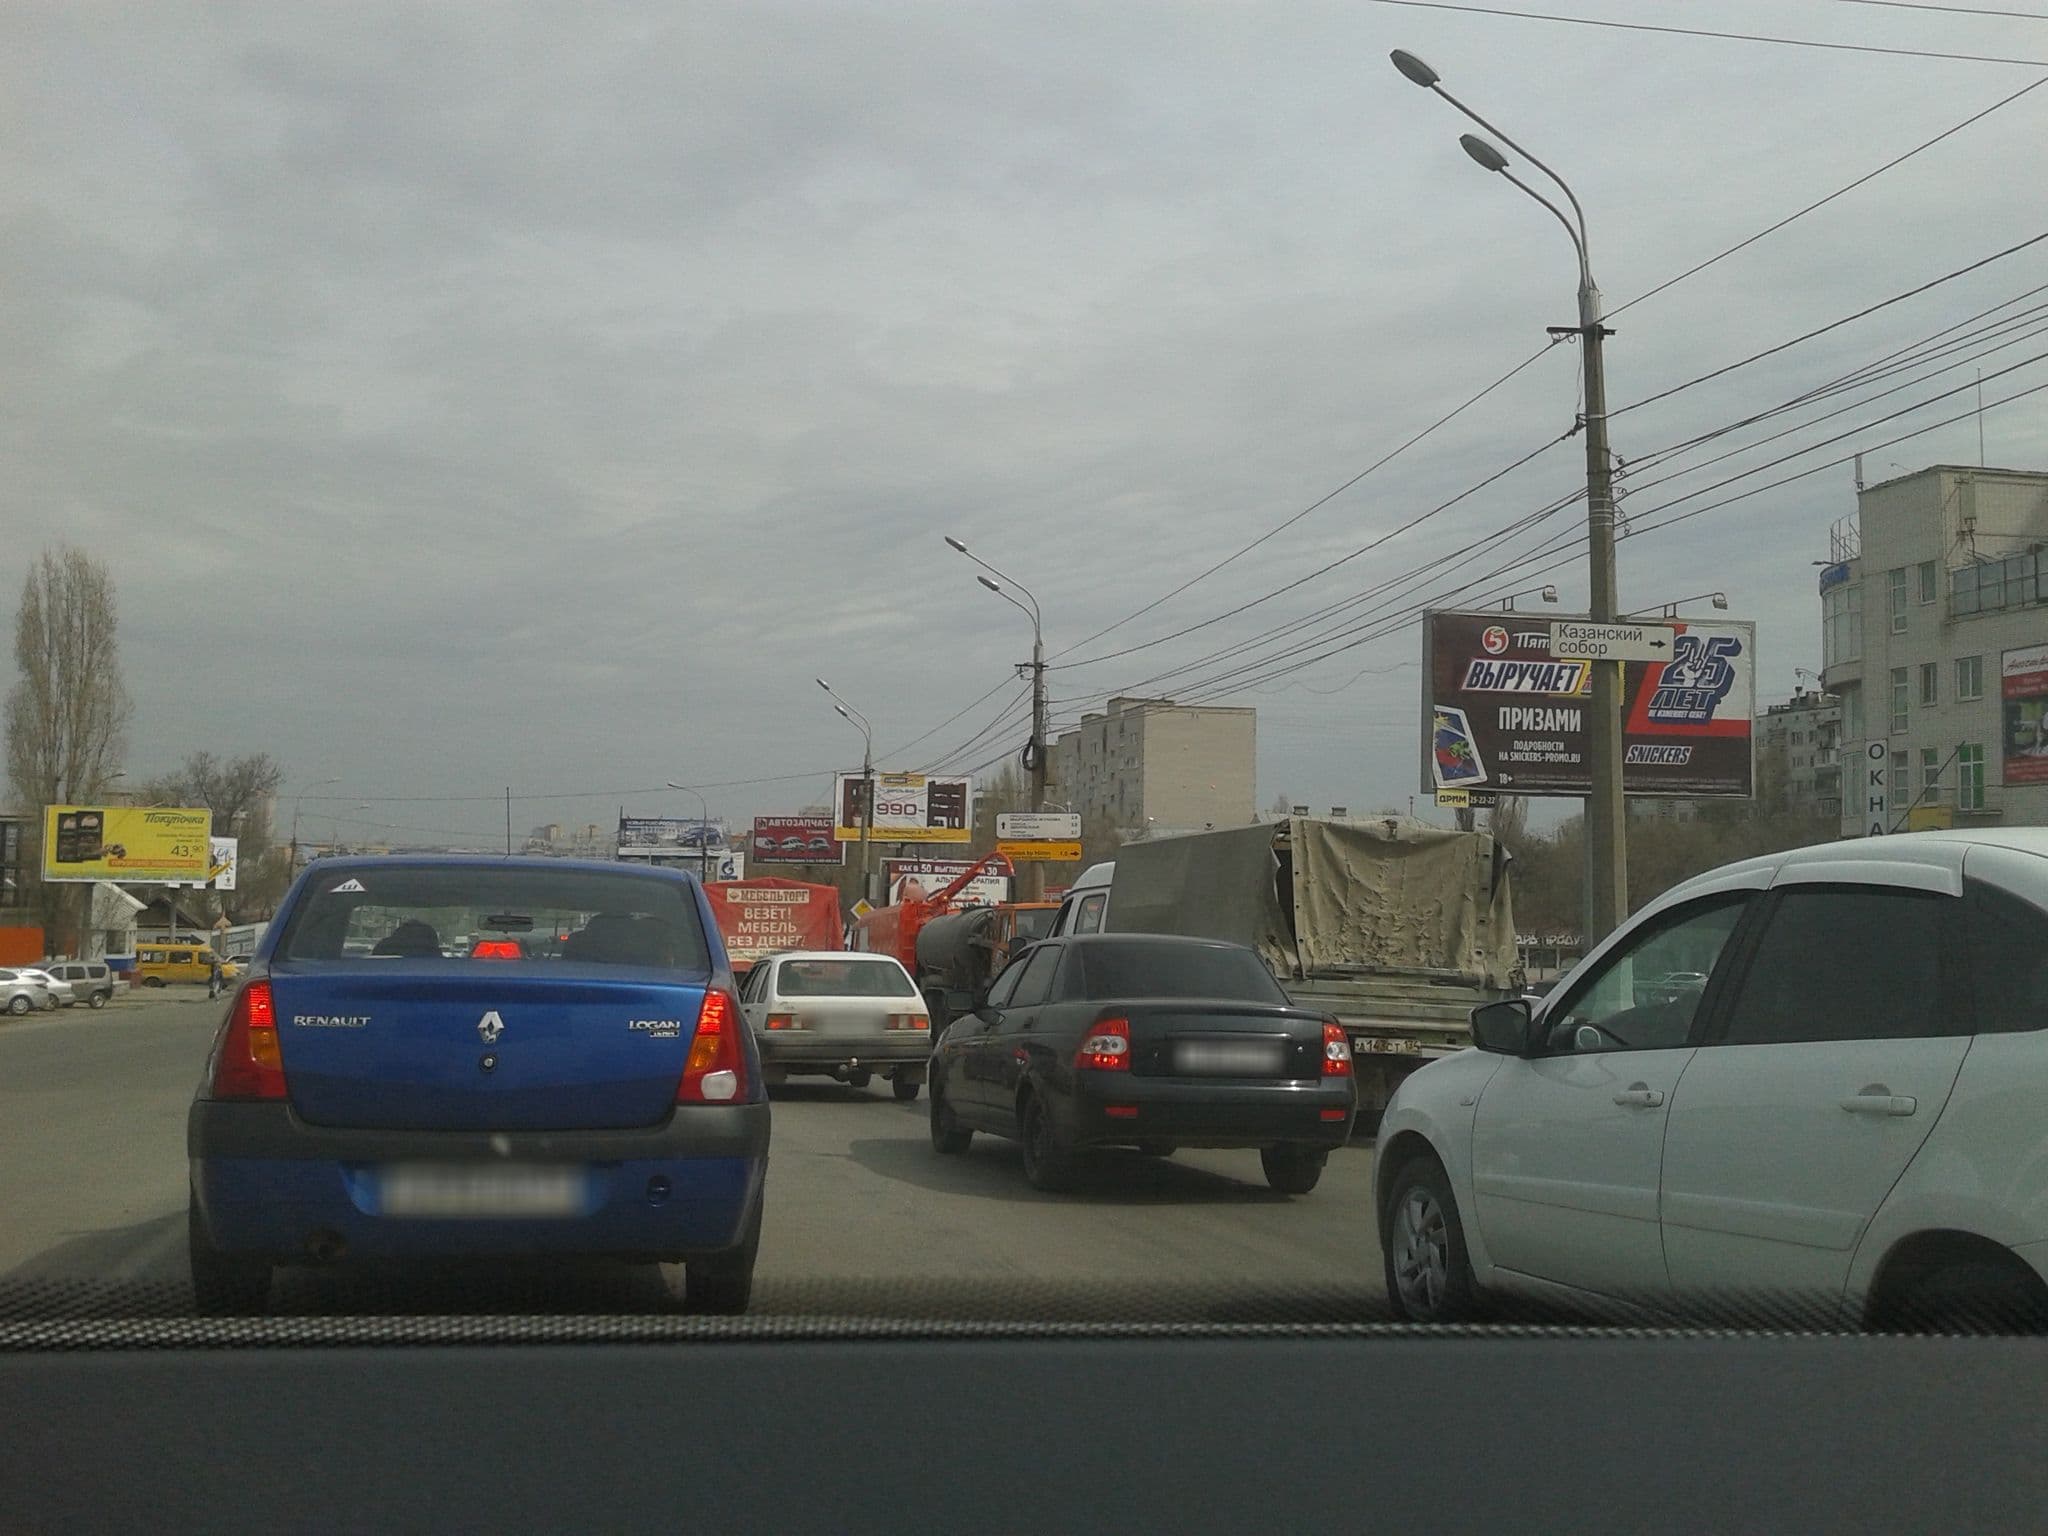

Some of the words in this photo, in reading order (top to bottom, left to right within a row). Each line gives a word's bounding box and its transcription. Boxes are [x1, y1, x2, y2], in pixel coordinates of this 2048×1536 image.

[1558, 624, 1643, 642] Казанский
[1558, 641, 1608, 658] собор
[1659, 636, 1742, 688] 25
[1467, 661, 1581, 693] ВЫРУЧАЕТ
[1647, 688, 1716, 710] ЛЕТ
[1498, 706, 1582, 733] ПРИЗАМИ
[1513, 740, 1565, 752] ПОДРОБНОСТИ
[1499, 753, 1509, 762] НА
[1510, 752, 1582, 764] SNICKERS-PROMO.RU
[1628, 746, 1690, 763] SNICKERS
[1499, 773, 1514, 785] 18+
[1869, 743, 1885, 837] ОКНА
[143, 812, 206, 827] Покупочка
[921, 864, 932, 873] 50
[987, 867, 998, 876] 30
[741, 889, 808, 902] МЕБЕЛЬТОРГ
[744, 905, 792, 920] ВЕЗЁТ!
[737, 921, 798, 934] МЕБЕЛЬ
[727, 936, 753, 946] БЕЗ
[756, 936, 806, 948] ДЕНЕГ!
[293, 1015, 372, 1027] RENAULT
[629, 1019, 681, 1030] LOGAN
